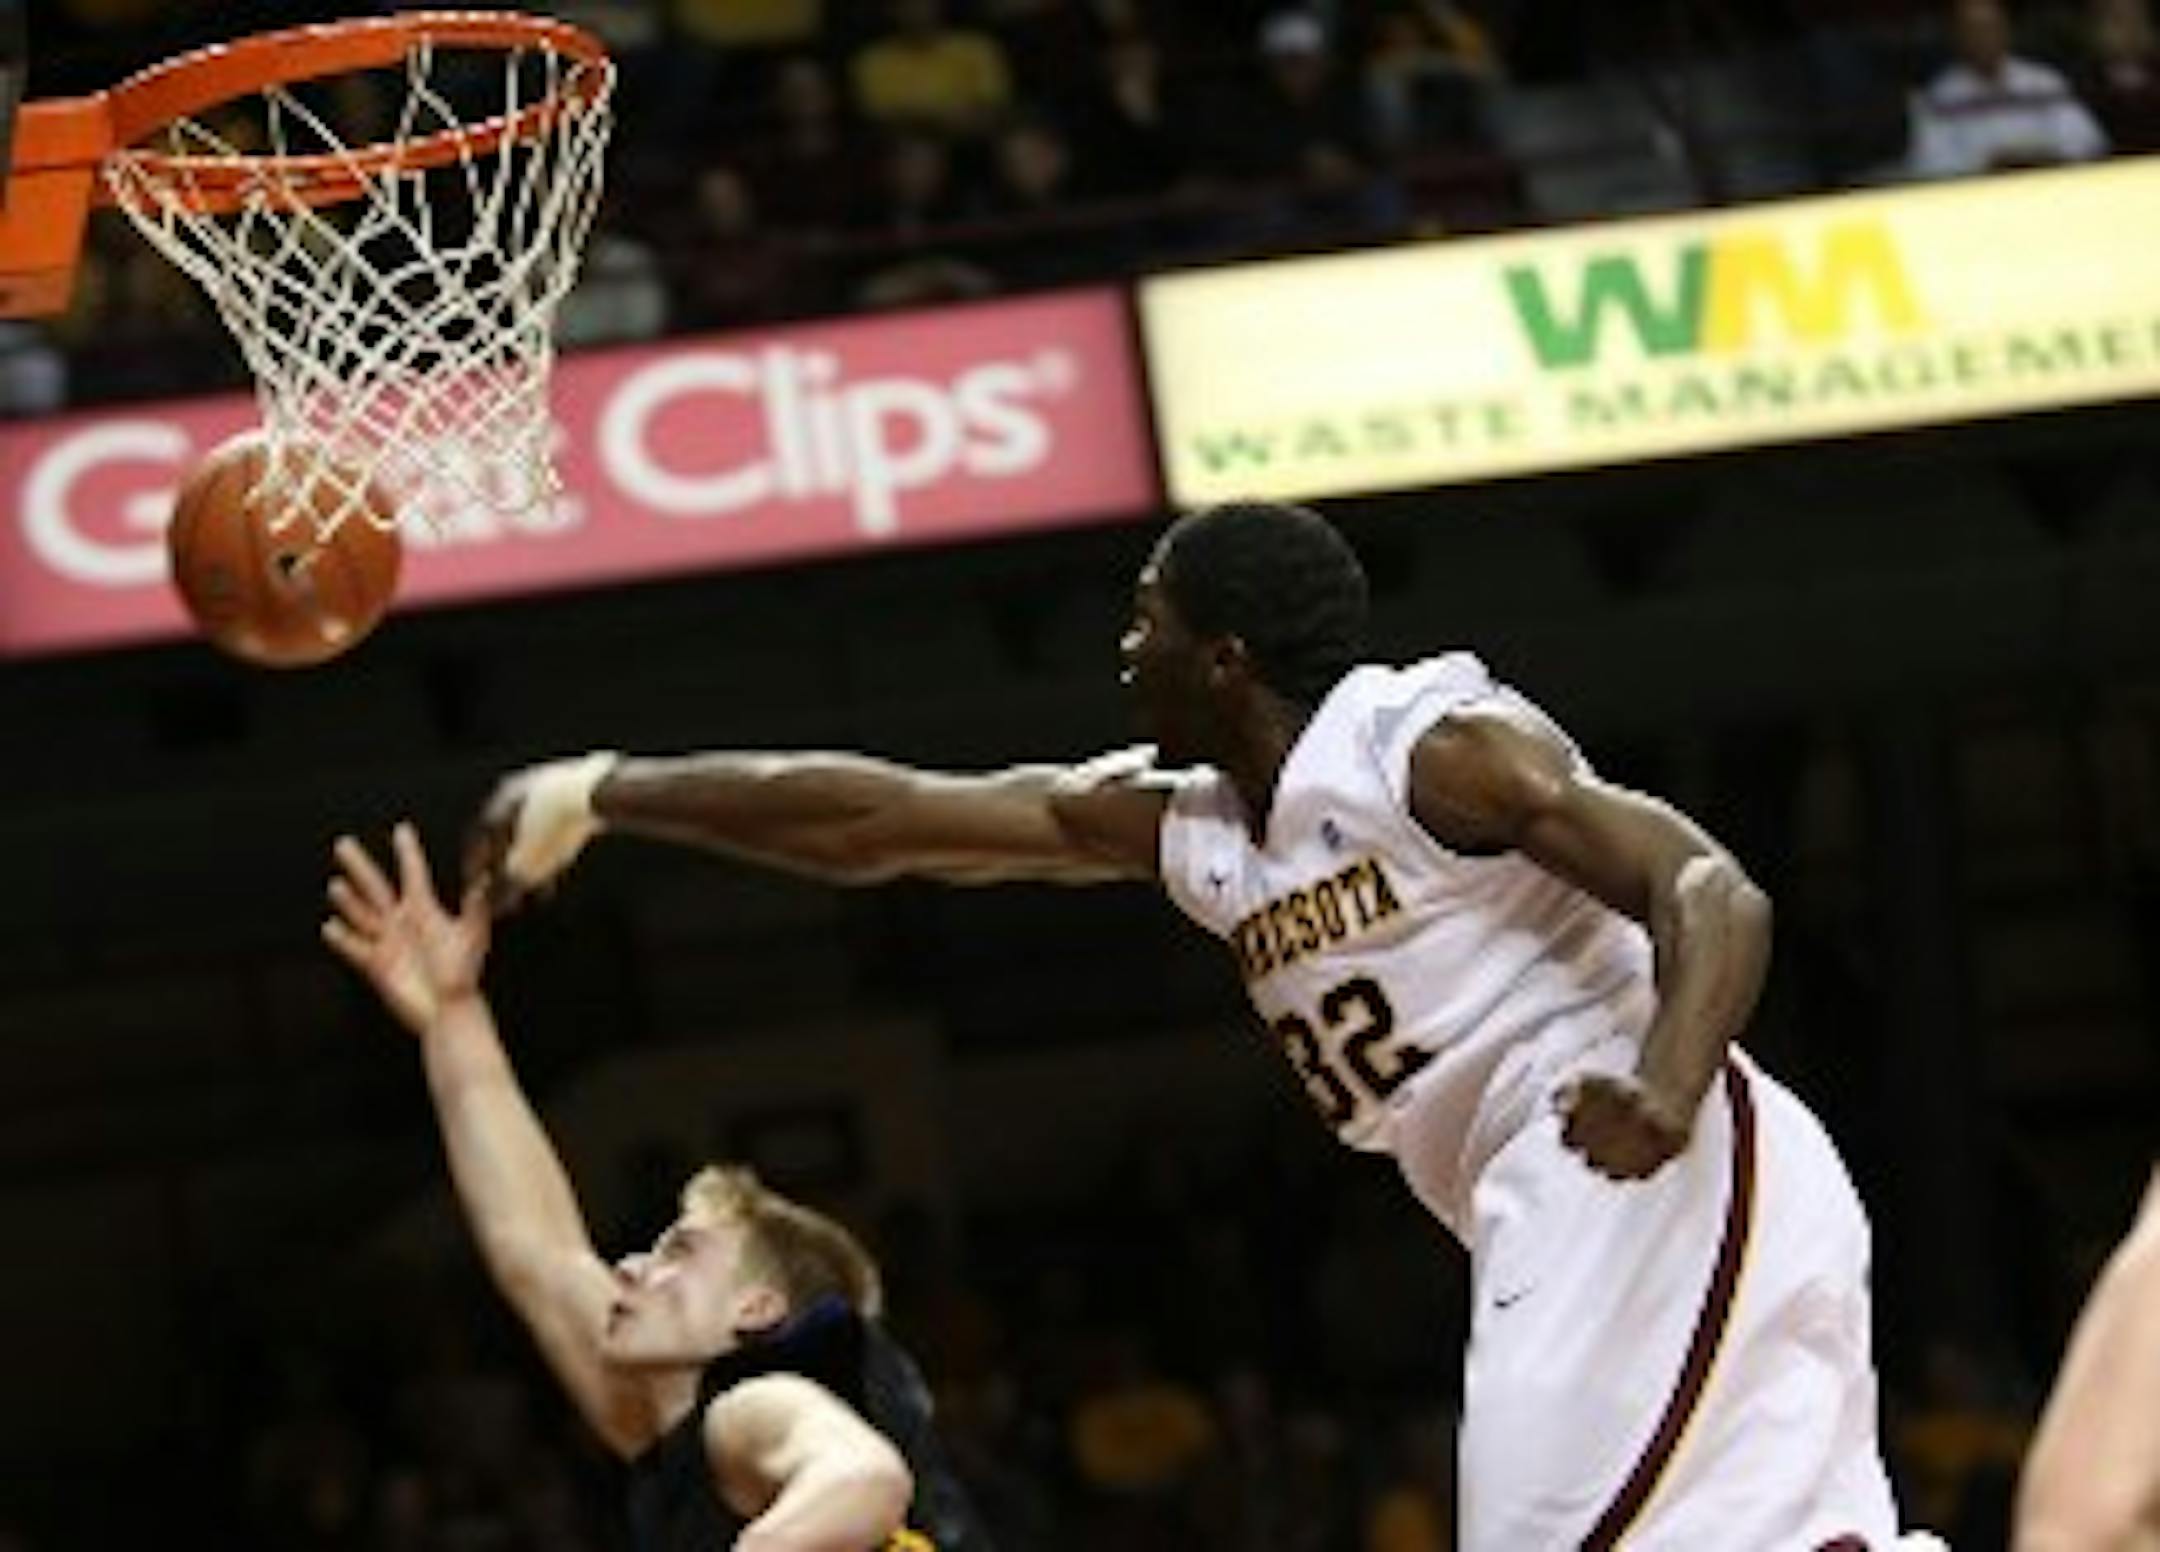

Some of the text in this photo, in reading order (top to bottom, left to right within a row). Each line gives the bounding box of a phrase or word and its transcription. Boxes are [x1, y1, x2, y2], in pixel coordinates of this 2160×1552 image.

[1505, 214, 1926, 370] WM
[1194, 316, 2160, 473] WASTE MANAGEME
[1272, 974, 1434, 1124] 32
